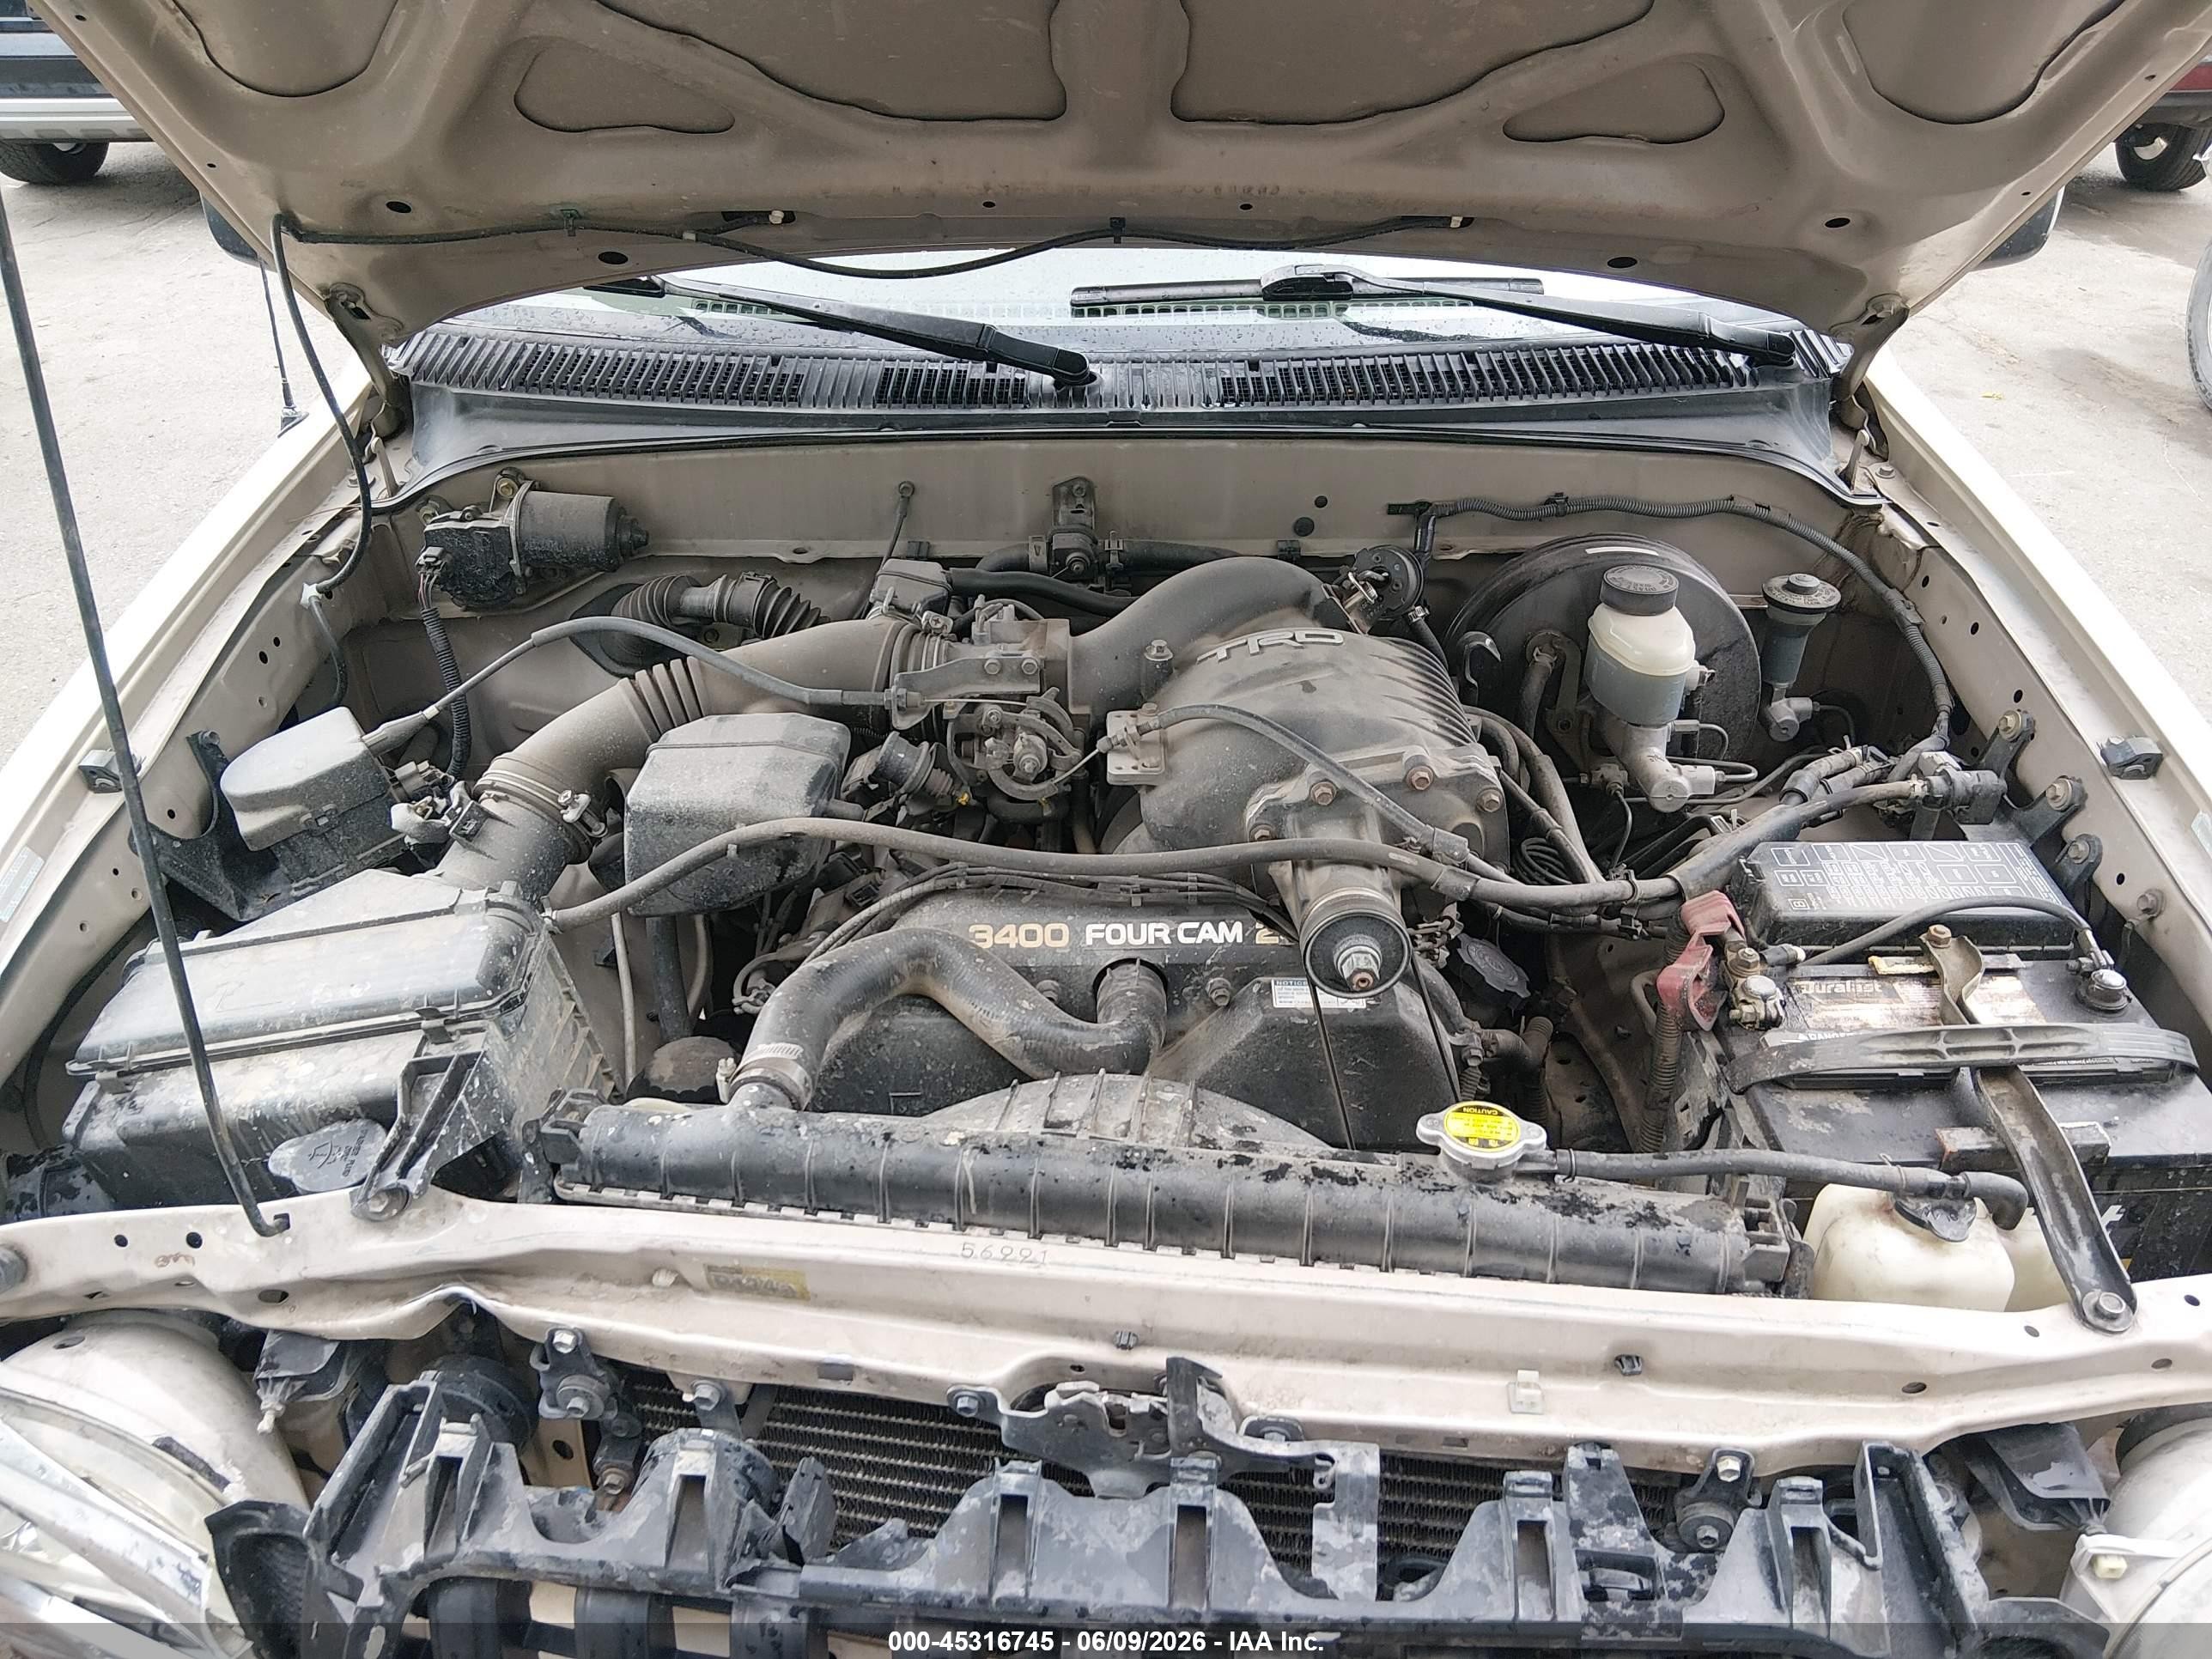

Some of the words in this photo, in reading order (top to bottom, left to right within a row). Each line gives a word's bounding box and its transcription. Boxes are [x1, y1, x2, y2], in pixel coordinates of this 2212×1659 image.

[1196, 629, 1345, 664] TRD
[969, 923, 1069, 948] 3400
[1085, 922, 1171, 945] FOUR
[1177, 921, 1243, 944] CAM
[1255, 921, 1285, 945] 2
[1462, 1107, 1498, 1115] CAUTION
